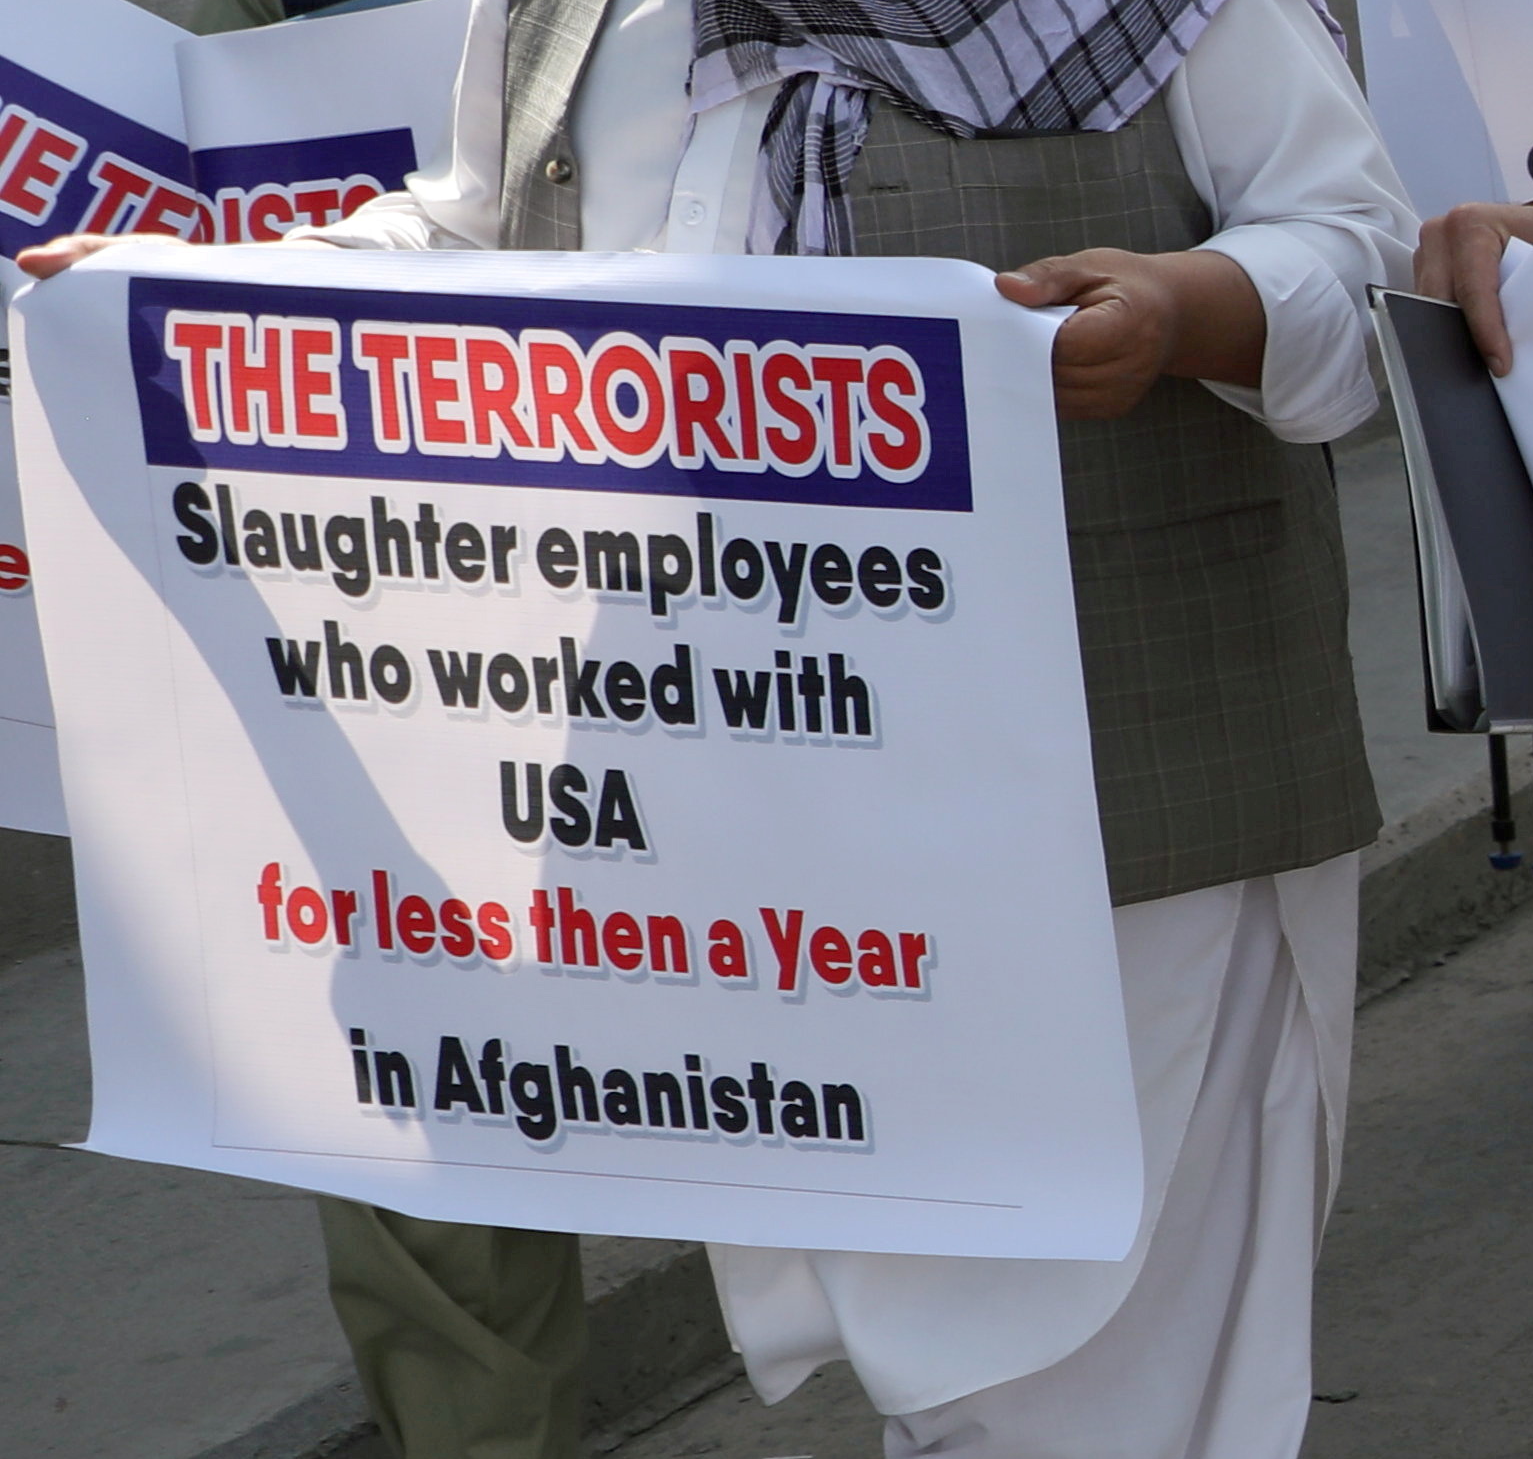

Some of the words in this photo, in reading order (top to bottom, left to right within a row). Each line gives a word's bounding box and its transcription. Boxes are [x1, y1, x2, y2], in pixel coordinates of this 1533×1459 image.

[173, 324, 339, 437] THE
[361, 333, 922, 471] TERRORISTS
[173, 481, 517, 598] Slaughter
[536, 511, 945, 624] employees
[266, 620, 412, 703] who
[427, 636, 696, 726] worked
[713, 650, 873, 736] with
[501, 761, 648, 851] USA
[257, 862, 357, 946] for
[373, 869, 512, 960] less
[529, 887, 690, 973] then
[708, 919, 747, 977] a
[759, 907, 927, 990] Year
[350, 1027, 416, 1108] in
[434, 1036, 865, 1141] Afghanistan
